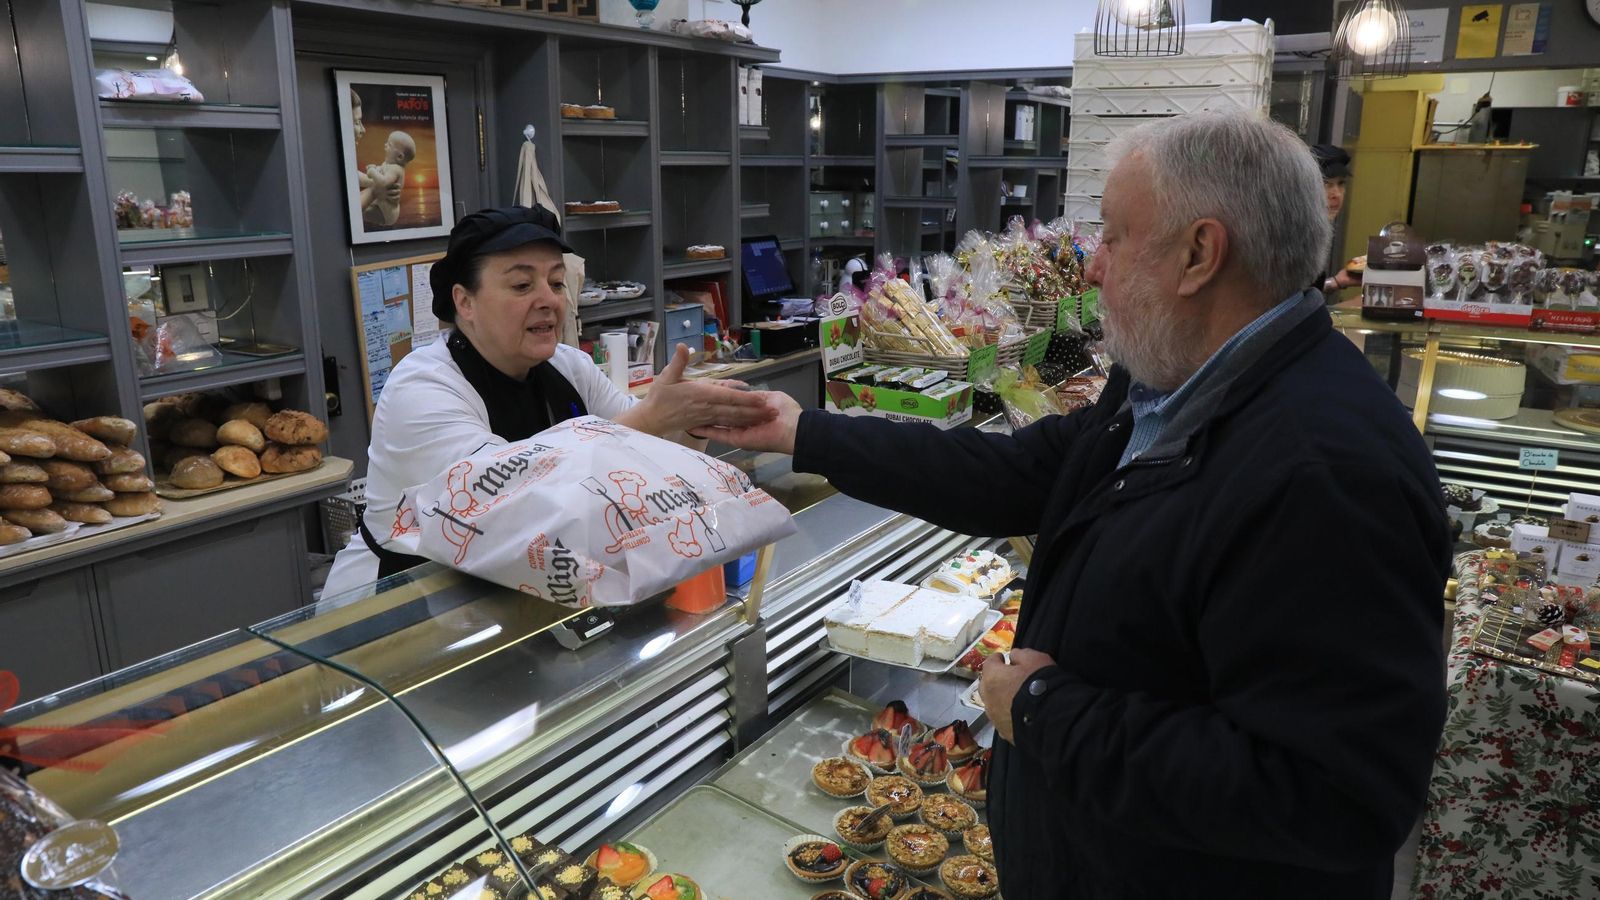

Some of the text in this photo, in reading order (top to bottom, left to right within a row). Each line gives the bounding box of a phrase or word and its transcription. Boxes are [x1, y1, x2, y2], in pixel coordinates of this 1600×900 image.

[829, 350, 861, 367] DUBAI CHOCOLATE
[885, 412, 902, 421] DUBAI
[472, 443, 555, 497] Miguel
